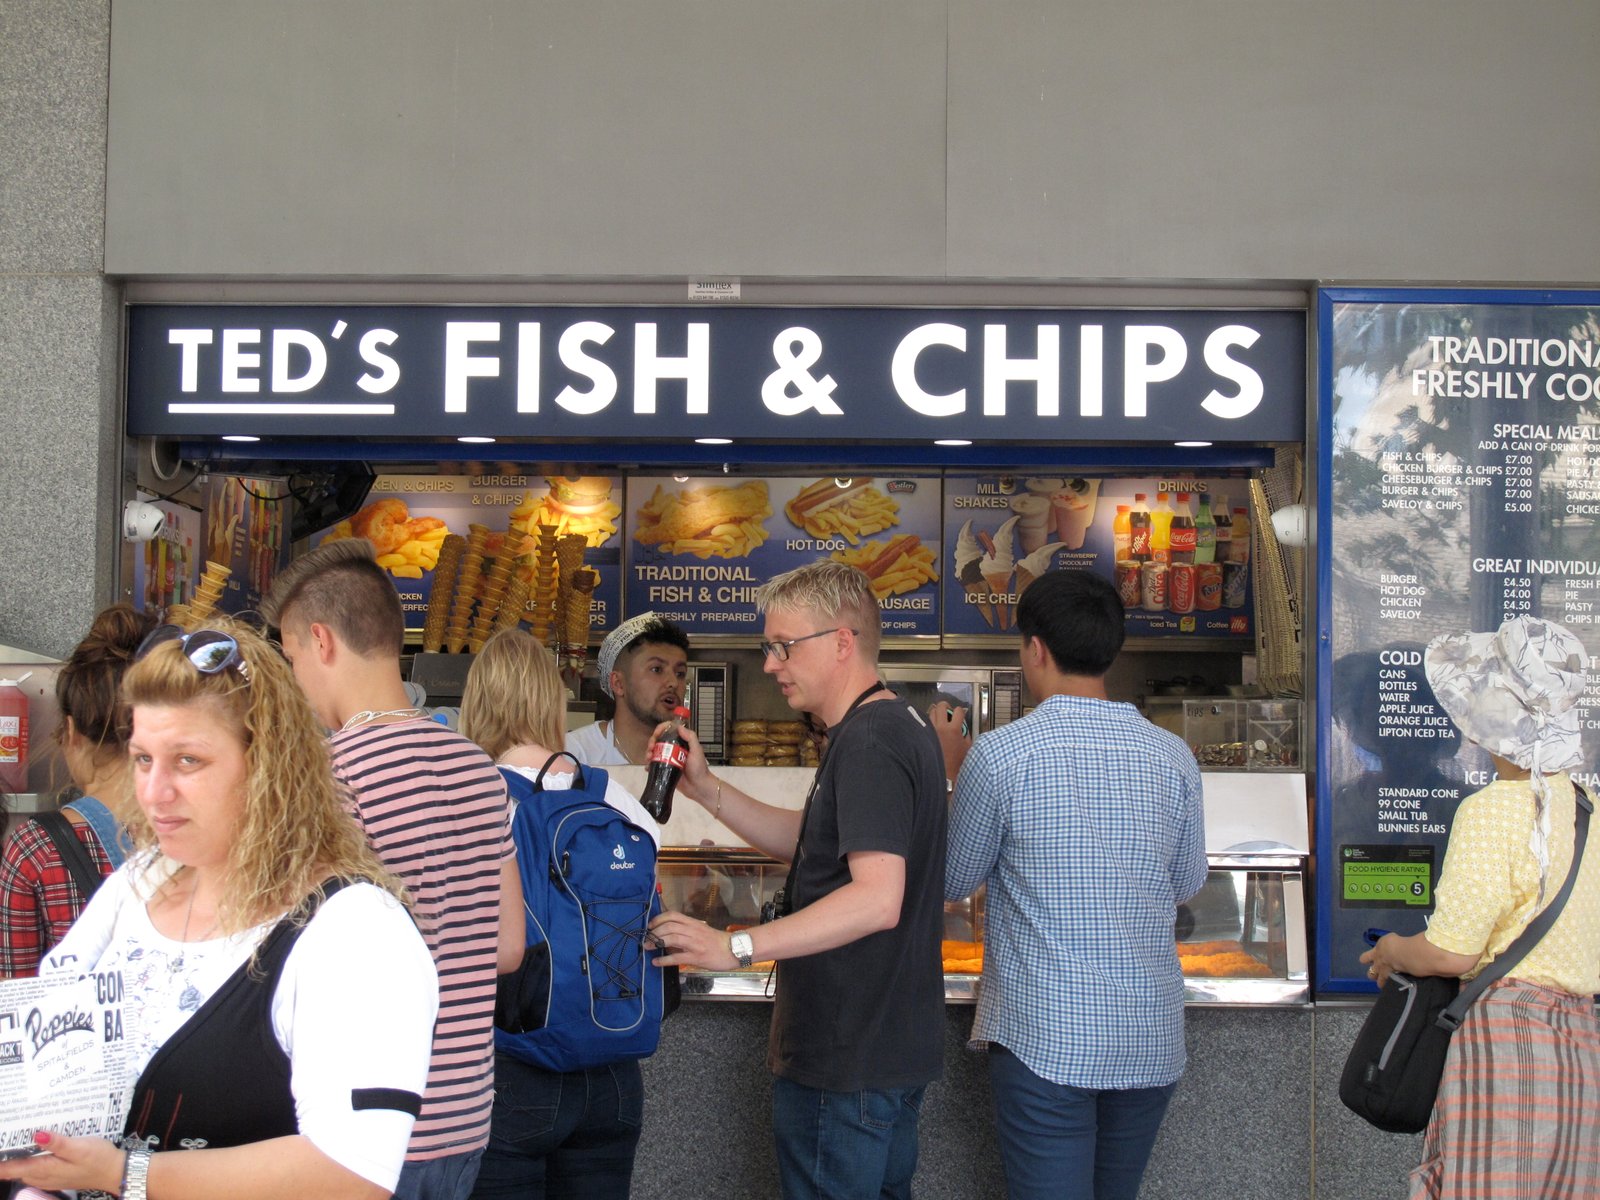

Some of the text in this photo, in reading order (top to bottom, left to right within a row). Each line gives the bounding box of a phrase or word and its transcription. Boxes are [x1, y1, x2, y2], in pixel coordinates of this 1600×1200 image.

[168, 320, 1264, 419] TED'S FISH & CHIPS
[1412, 369, 1537, 399] FRESHLY
[1493, 424, 1600, 441] SPECIAL MEAL
[1478, 441, 1499, 450] ADD
[1501, 441, 1509, 450] A
[1511, 442, 1532, 451] CAN
[1535, 442, 1548, 452] OF
[1550, 443, 1580, 452] DRINK
[1382, 451, 1533, 465] FISH & CHIPS £7.00
[1567, 457, 1587, 466] HOT
[1382, 463, 1533, 476] CHICKEN BURGER & CHIPS £7.00
[1567, 468, 1580, 477] PIE
[1582, 468, 1591, 477] &
[404, 480, 413, 491] &
[416, 480, 454, 491] CHIPS
[473, 475, 527, 486] BURGER
[1382, 474, 1532, 488] CHEESEBURGER & CHIPS £7.00
[1566, 479, 1594, 489] PASTY
[1158, 481, 1208, 492] DRINKS
[1382, 485, 1532, 499] BURGER & CHIPS £7.00
[472, 494, 523, 505] & CHIPS
[954, 496, 1008, 508] SHAKES
[1382, 499, 1532, 513] SAVELOY & CHIPS £5.00
[786, 539, 845, 551] HOT DOG
[1473, 558, 1522, 573] GREAT
[635, 565, 757, 581] TRADITIONAL
[1380, 575, 1531, 587] BURGER £4.50
[1565, 579, 1594, 589] FRESH
[649, 586, 693, 602] FISH
[697, 587, 712, 602] &
[1380, 586, 1531, 599] HOT DOG £4.00
[1565, 590, 1579, 600] PIE
[965, 593, 986, 604] ICE
[1380, 597, 1531, 610] CHICKEN £4.50
[1565, 602, 1593, 612] PASTY
[702, 612, 757, 622] PREPARED
[1380, 609, 1422, 619] SAVELOY
[1565, 614, 1593, 624] CHIPS
[893, 621, 917, 629] CHIPS
[1379, 651, 1422, 666] COLD
[1379, 669, 1406, 679] CANS
[1379, 681, 1417, 691] BOTTLES
[1379, 693, 1410, 702] WATER
[1379, 704, 1434, 714] APPLE JUICE
[1378, 716, 1448, 726] ORANGE JUICE
[1378, 727, 1455, 738] LIPTON ICED TEA
[1464, 770, 1487, 785] ICE
[1378, 787, 1459, 799] STANDARD CONE
[1378, 799, 1421, 809] 99 CONE
[1378, 810, 1428, 821] SMALL TUB
[1378, 823, 1446, 834] BUNNIES EARS
[610, 861, 636, 870] deuter
[1348, 865, 1369, 873] FOOD
[1370, 865, 1399, 873] HYGIENE
[1413, 883, 1422, 895] 5
[37, 1039, 95, 1071] SPITALFIELDS
[49, 1065, 86, 1087] CAMDEN
